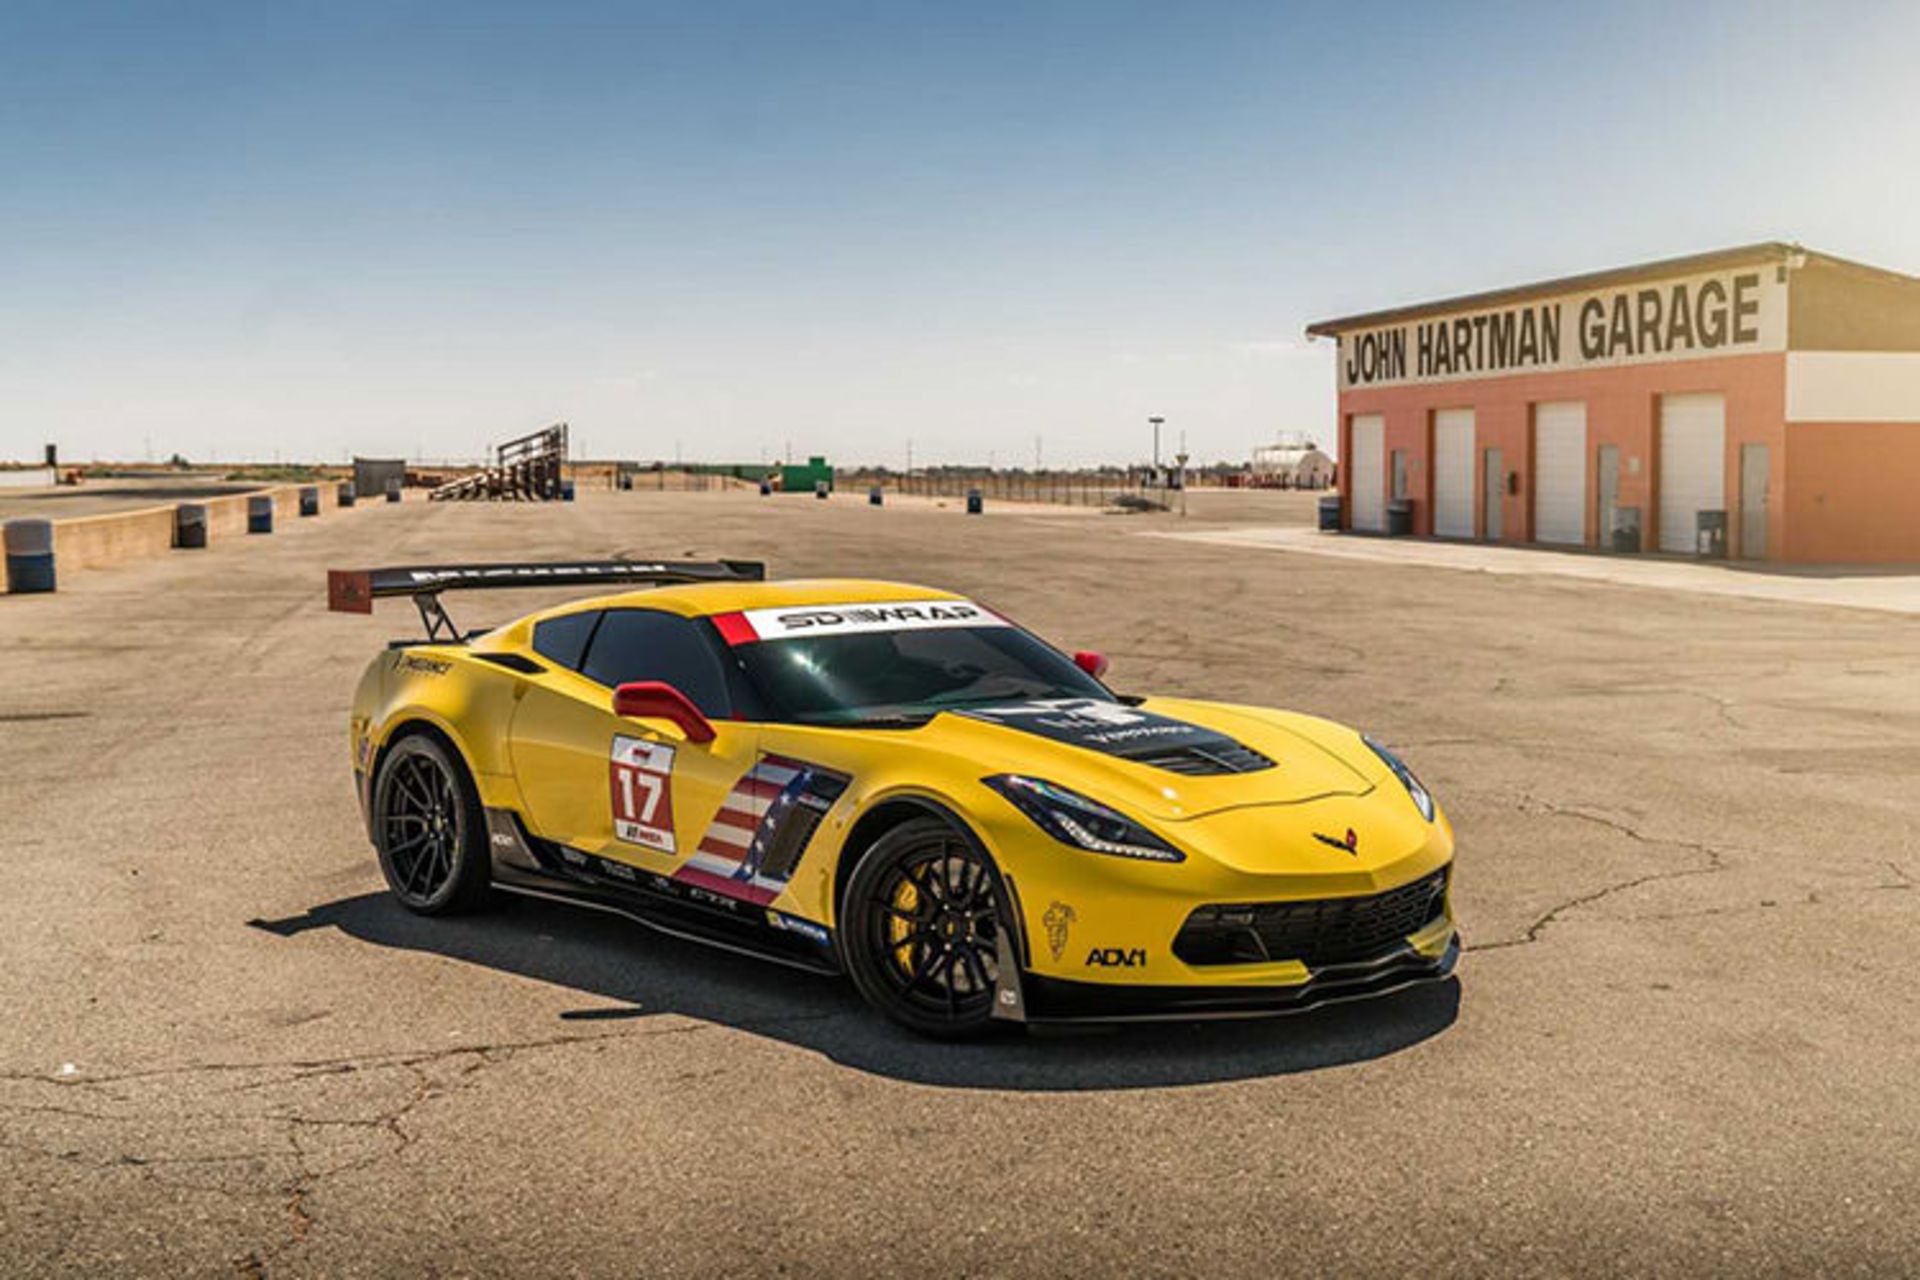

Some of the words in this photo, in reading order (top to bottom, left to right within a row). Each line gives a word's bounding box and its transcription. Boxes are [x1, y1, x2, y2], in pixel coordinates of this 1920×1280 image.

[1347, 326, 1406, 384] JOHN
[1417, 303, 1561, 377] HARTMAN
[1579, 273, 1759, 360] GARAGE
[618, 768, 662, 823] 17
